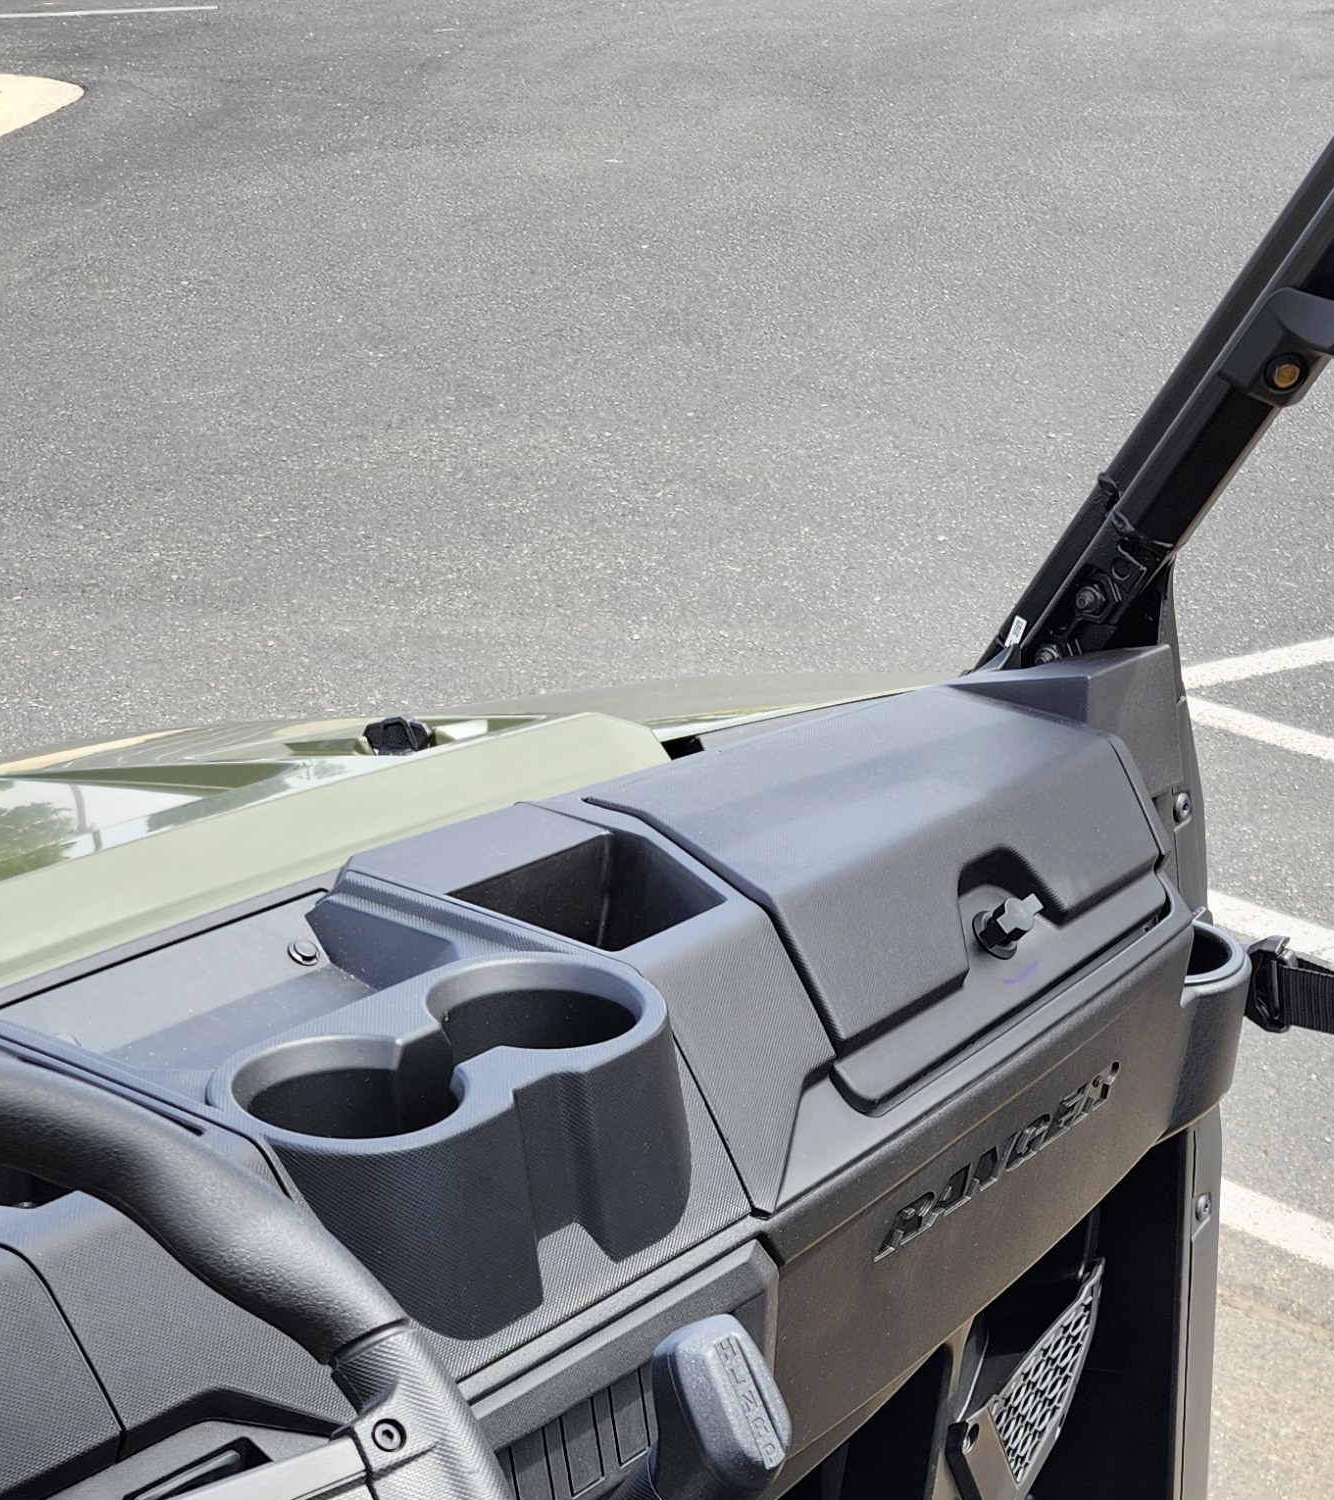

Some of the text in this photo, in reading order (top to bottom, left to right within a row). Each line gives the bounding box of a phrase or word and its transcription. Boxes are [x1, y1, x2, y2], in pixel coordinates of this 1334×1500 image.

[873, 1061, 1120, 1263] RANGER
[730, 1368, 746, 1385] L
[741, 1389, 759, 1413] N
